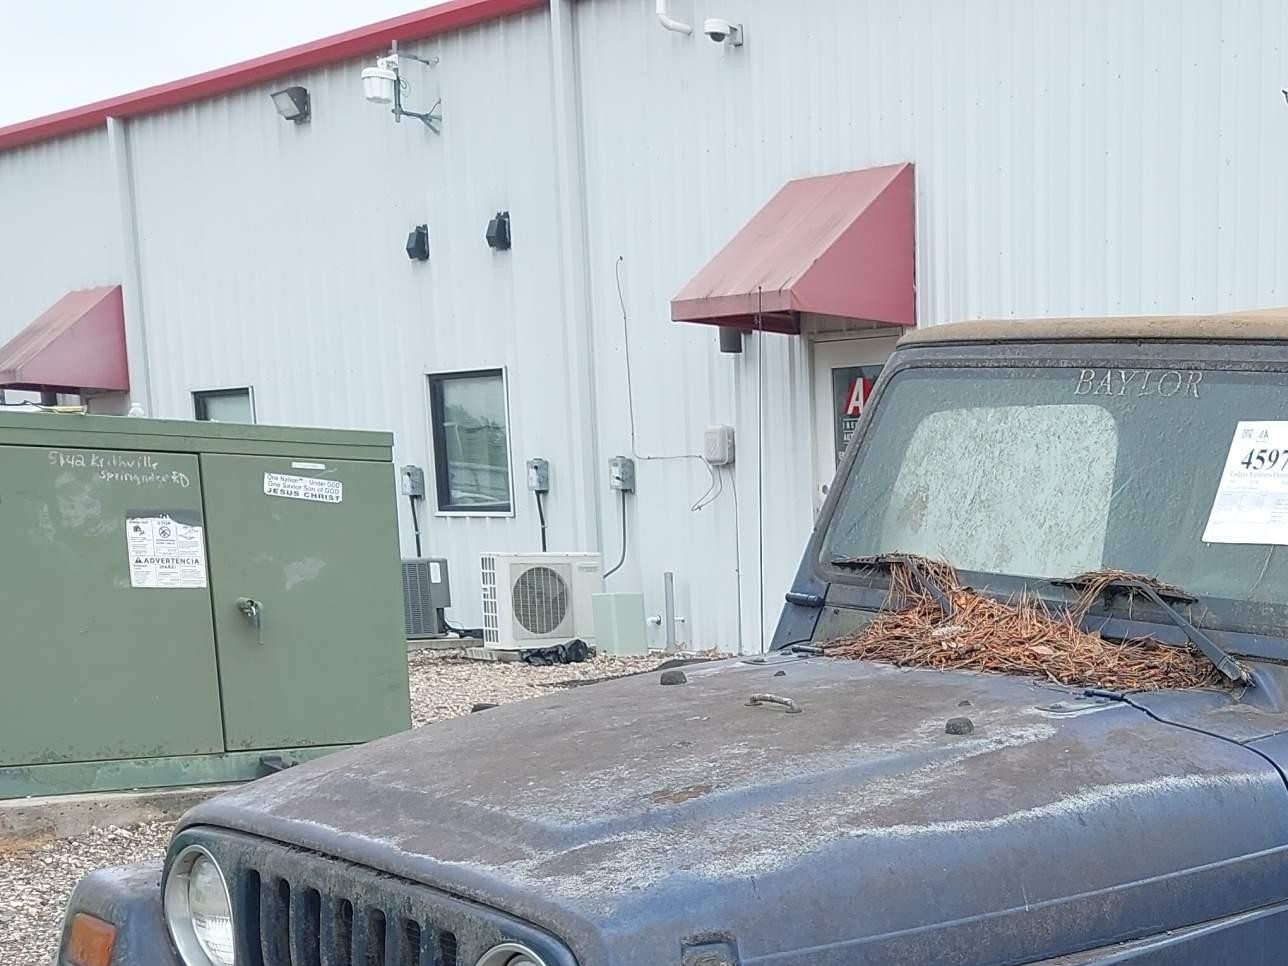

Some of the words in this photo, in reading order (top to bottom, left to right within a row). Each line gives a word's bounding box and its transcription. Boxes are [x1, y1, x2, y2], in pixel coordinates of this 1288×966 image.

[267, 487, 300, 497] JESUS
[303, 491, 341, 502] CHRIST
[144, 557, 200, 565] ADVERTENCIA
